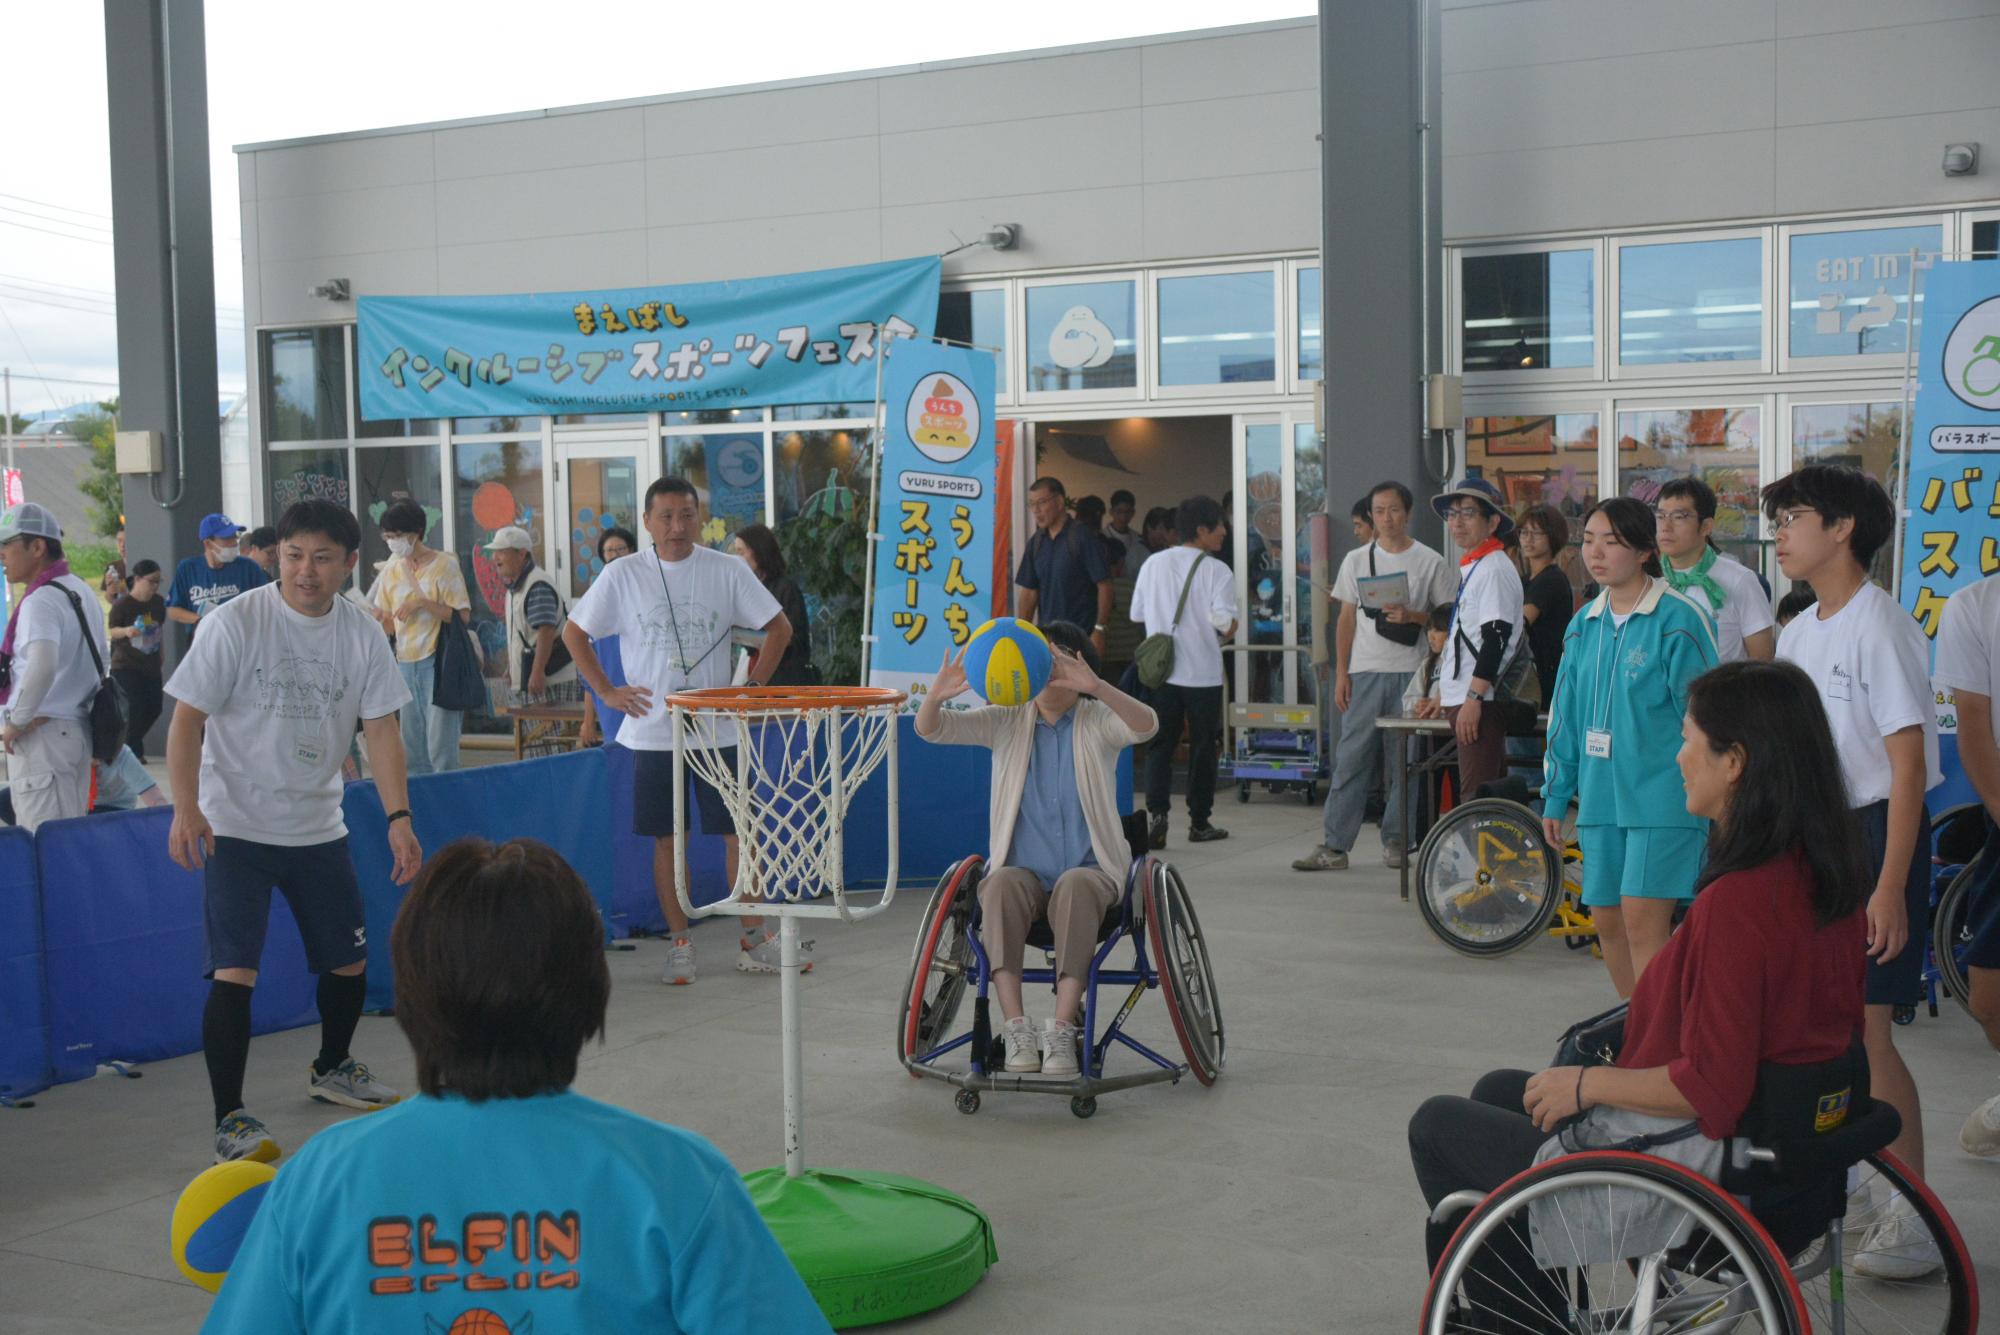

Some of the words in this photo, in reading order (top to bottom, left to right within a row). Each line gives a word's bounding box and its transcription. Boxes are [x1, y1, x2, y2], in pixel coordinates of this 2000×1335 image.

[1816, 256, 1865, 282] EAT
[574, 302, 689, 335] まえばし
[651, 390, 700, 401] SPORTS
[931, 401, 957, 412] うんち
[906, 477, 935, 488] YURU
[938, 480, 975, 492] SPORTS
[892, 500, 937, 646] スポーツ
[944, 504, 977, 646] うんち
[189, 583, 240, 603] Dodgers
[368, 1208, 581, 1269] ELFIN
